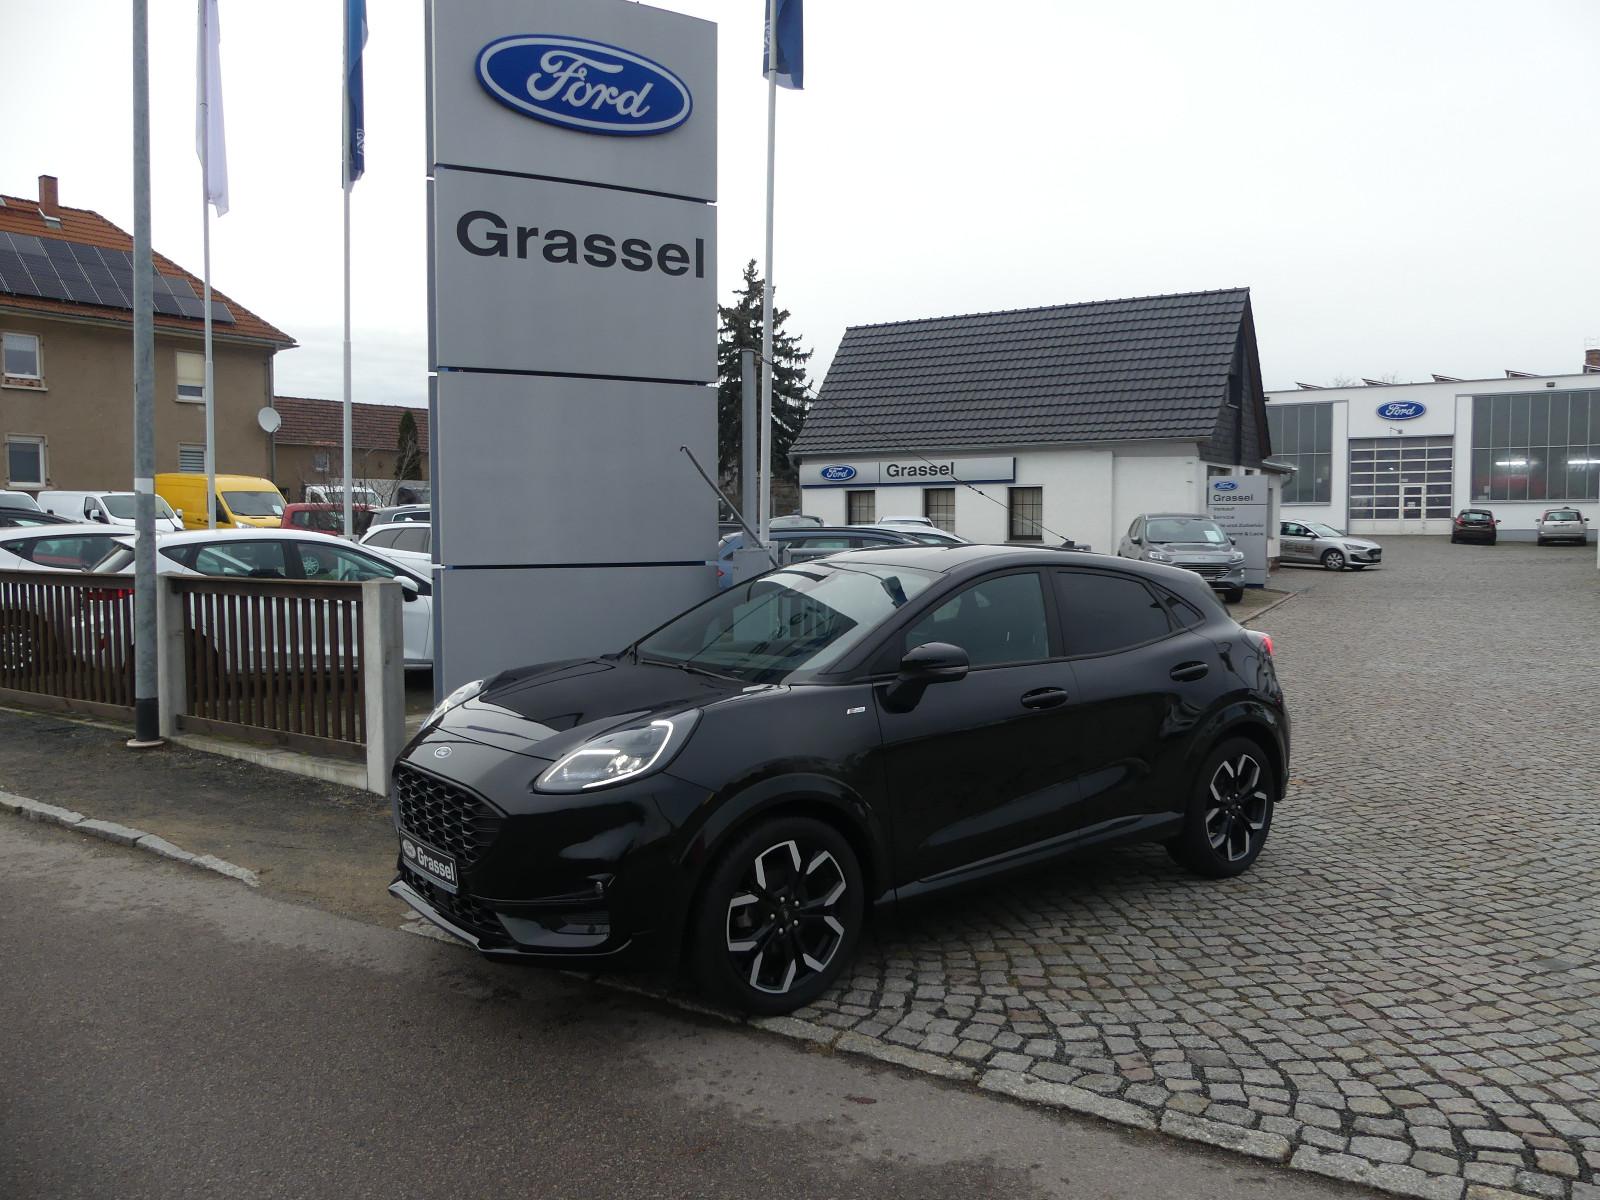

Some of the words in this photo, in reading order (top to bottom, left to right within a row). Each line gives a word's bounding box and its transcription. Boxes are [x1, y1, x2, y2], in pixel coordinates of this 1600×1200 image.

[526, 50, 654, 118] Ford
[456, 210, 706, 279] Grassel
[1385, 403, 1416, 416] Ford
[826, 467, 848, 478] Ford
[886, 461, 955, 478] Grassel
[1213, 494, 1254, 502] Grassel
[416, 846, 455, 882] Grassel
